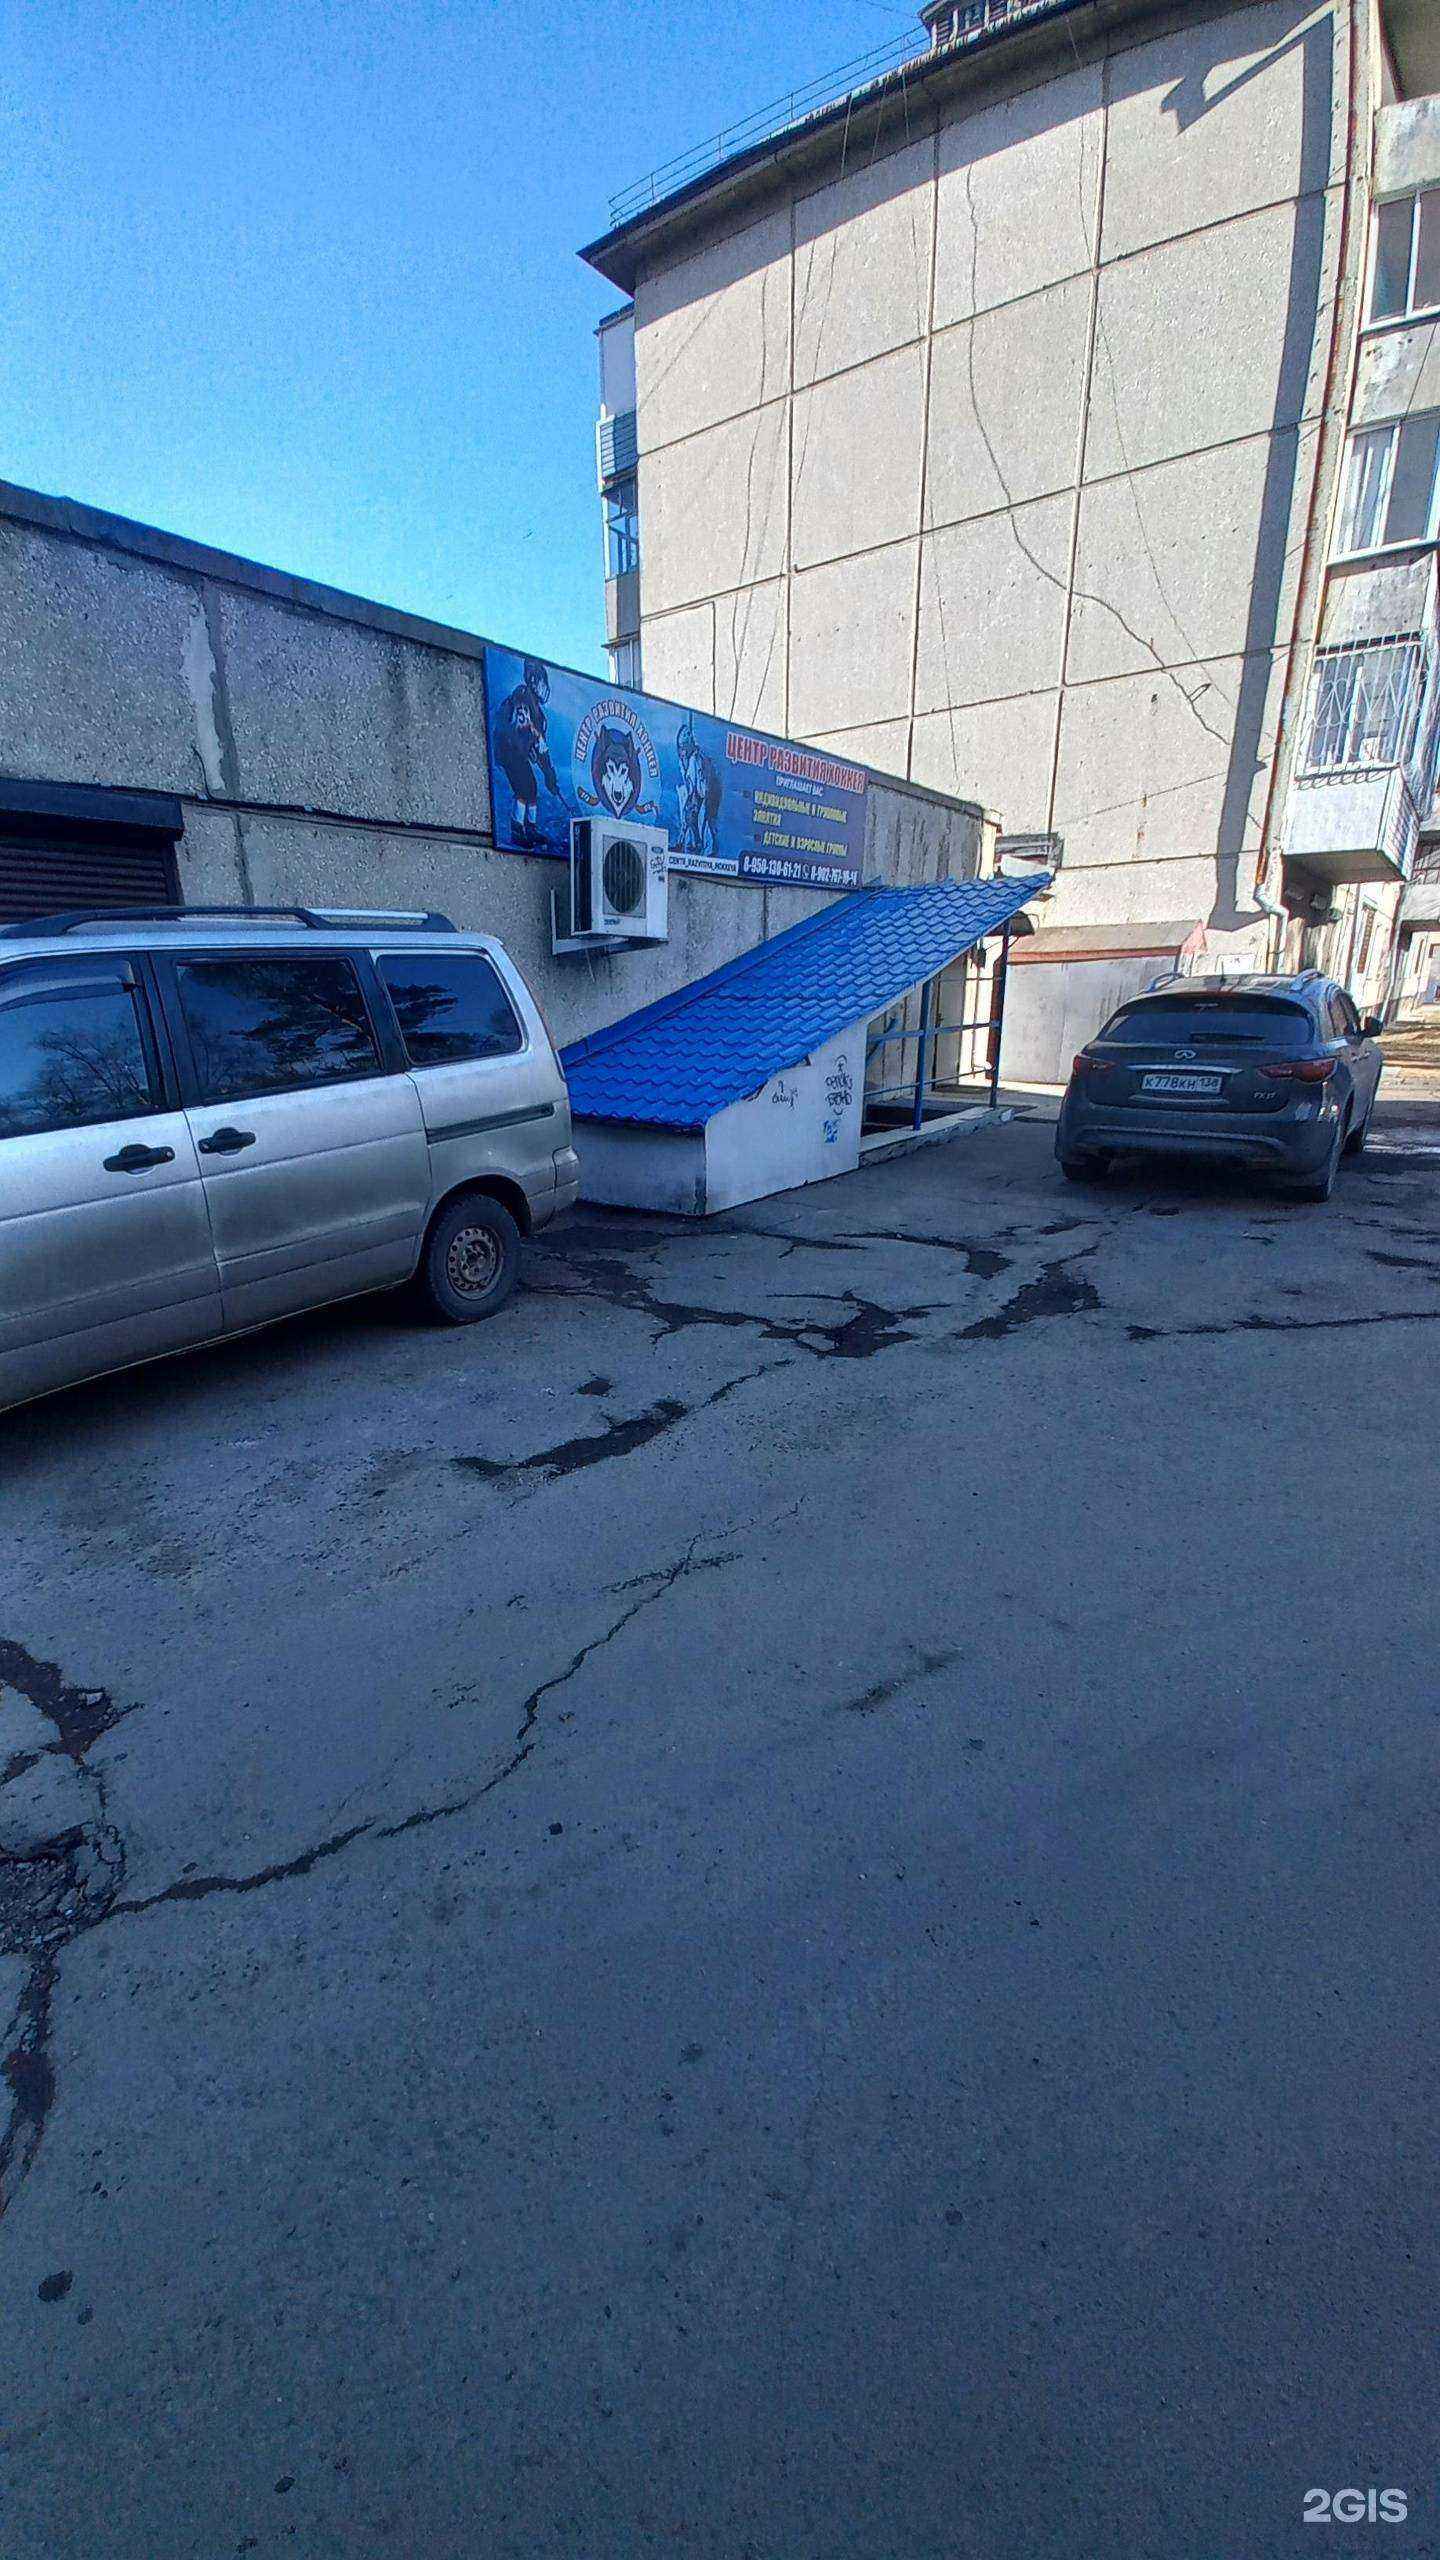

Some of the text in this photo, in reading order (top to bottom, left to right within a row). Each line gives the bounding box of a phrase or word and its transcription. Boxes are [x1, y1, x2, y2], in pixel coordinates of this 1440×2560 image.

[575, 715, 594, 763] ЦЕНТР
[591, 700, 638, 730] РАЗВИТИЯ
[726, 732, 867, 795] ЦЕНТР РАЗВИТИЯ ХОККЕЯ
